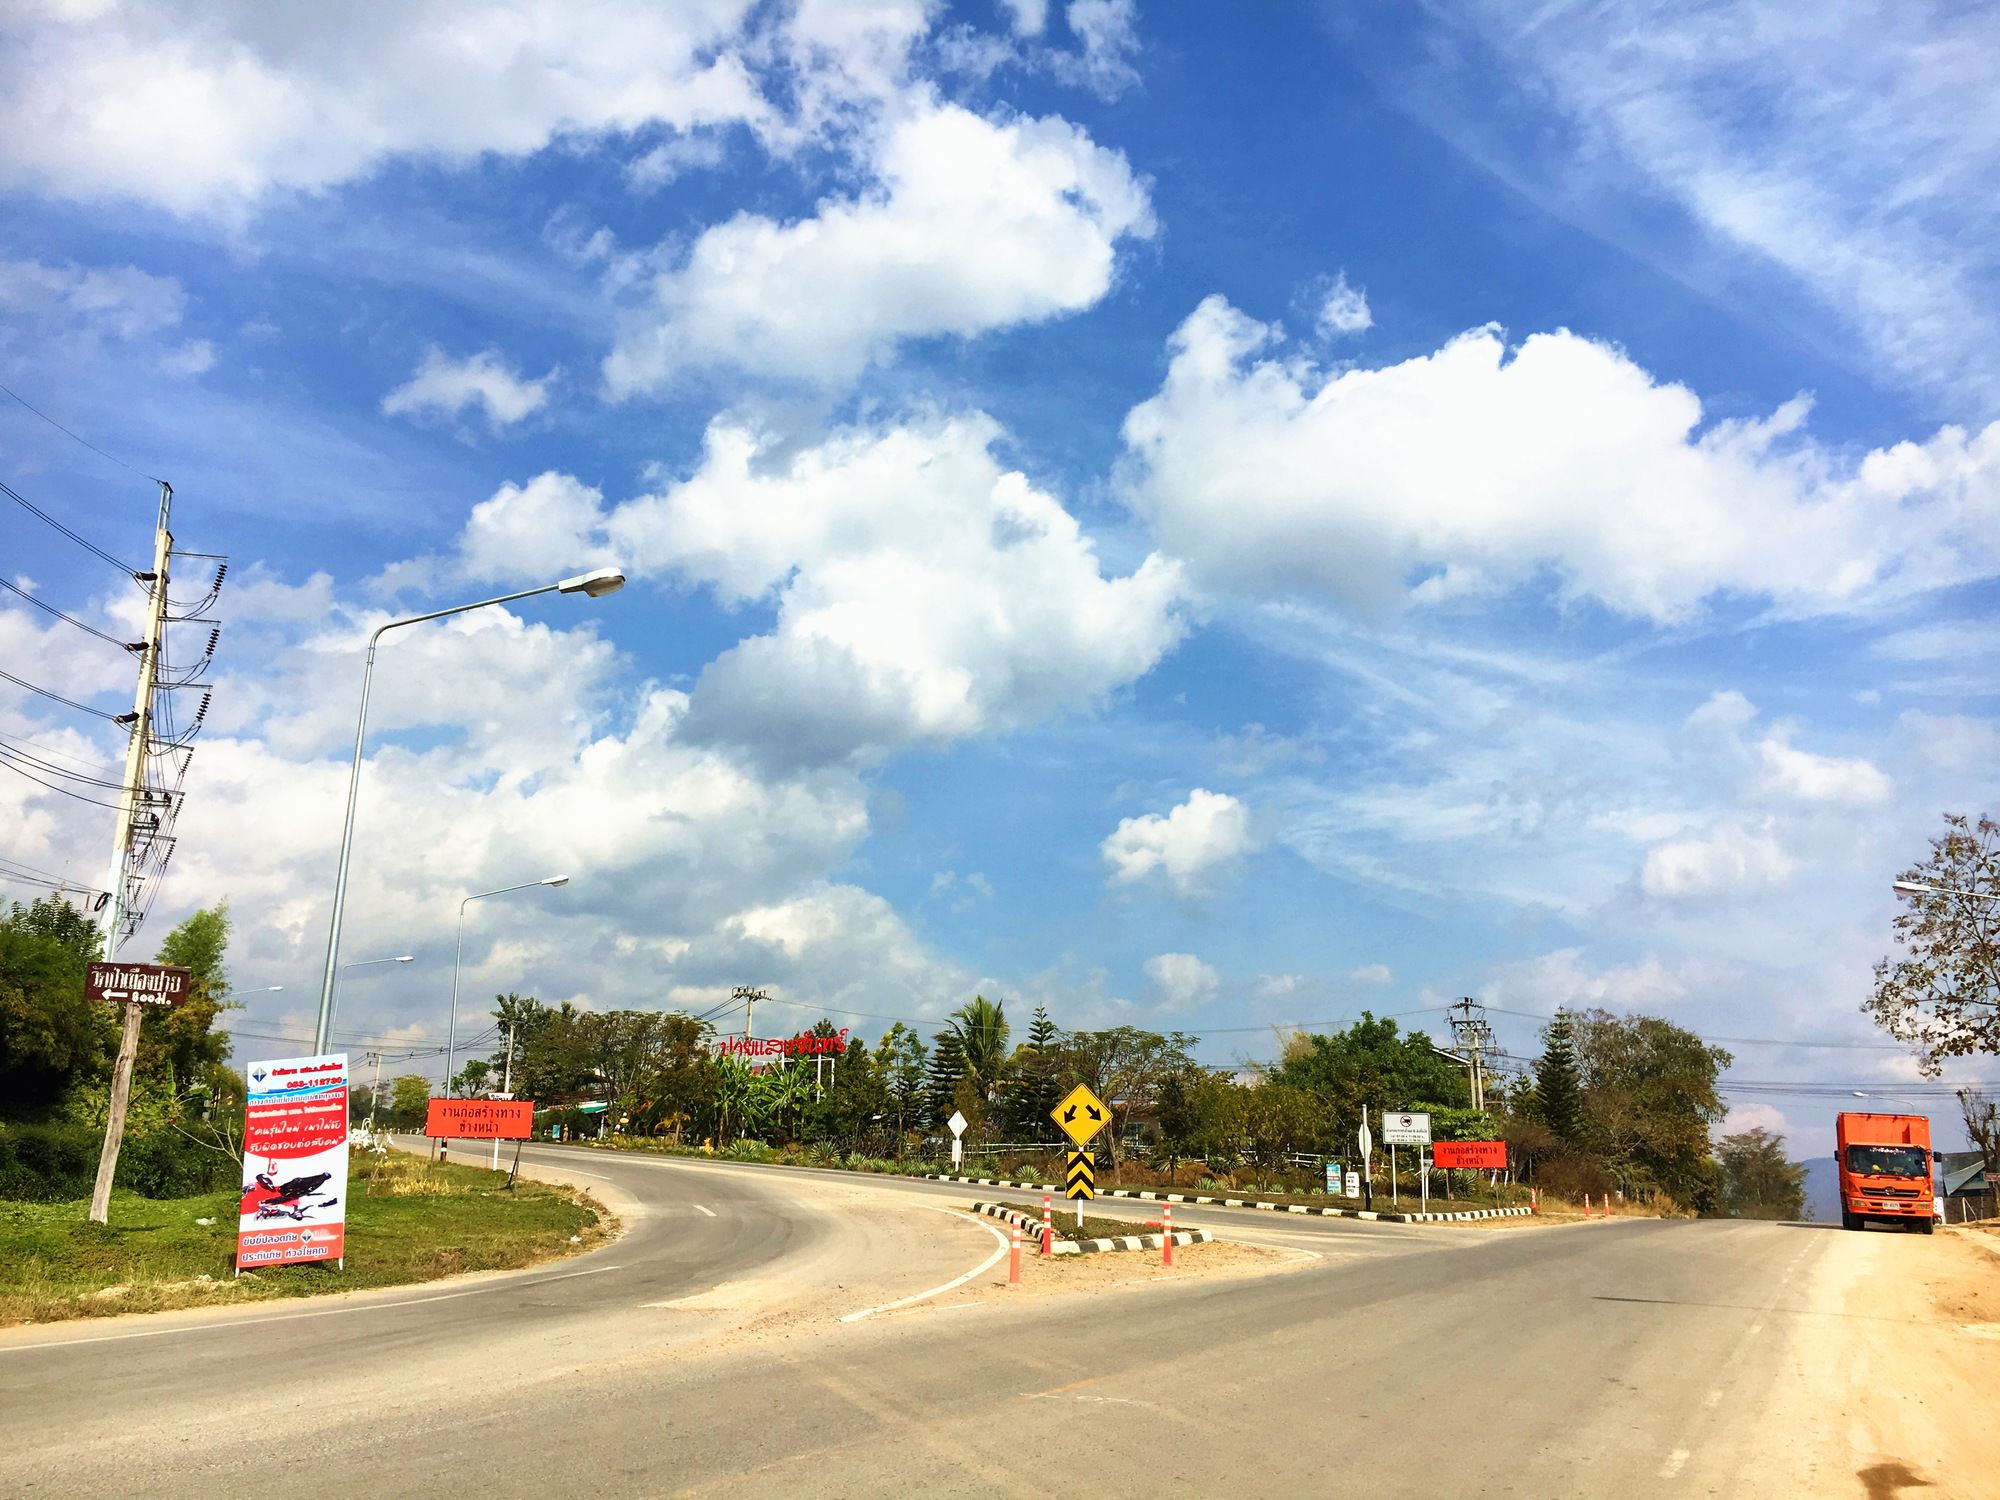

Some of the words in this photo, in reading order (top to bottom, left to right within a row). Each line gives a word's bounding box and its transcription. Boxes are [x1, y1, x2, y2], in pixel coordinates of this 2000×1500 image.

[442, 1104, 521, 1119] งานก่อสร้างทาง
[459, 1120, 499, 1133] ข้างหน้า
[1442, 1145, 1498, 1155] งานก่อสร้างทาง
[1456, 1156, 1484, 1165] ข้างหน้า
[243, 1233, 298, 1246] ขับขี่ปลอดภัย
[242, 1250, 281, 1261] ประกันภัย
[285, 1246, 328, 1257] ห่วงใยคุณ
